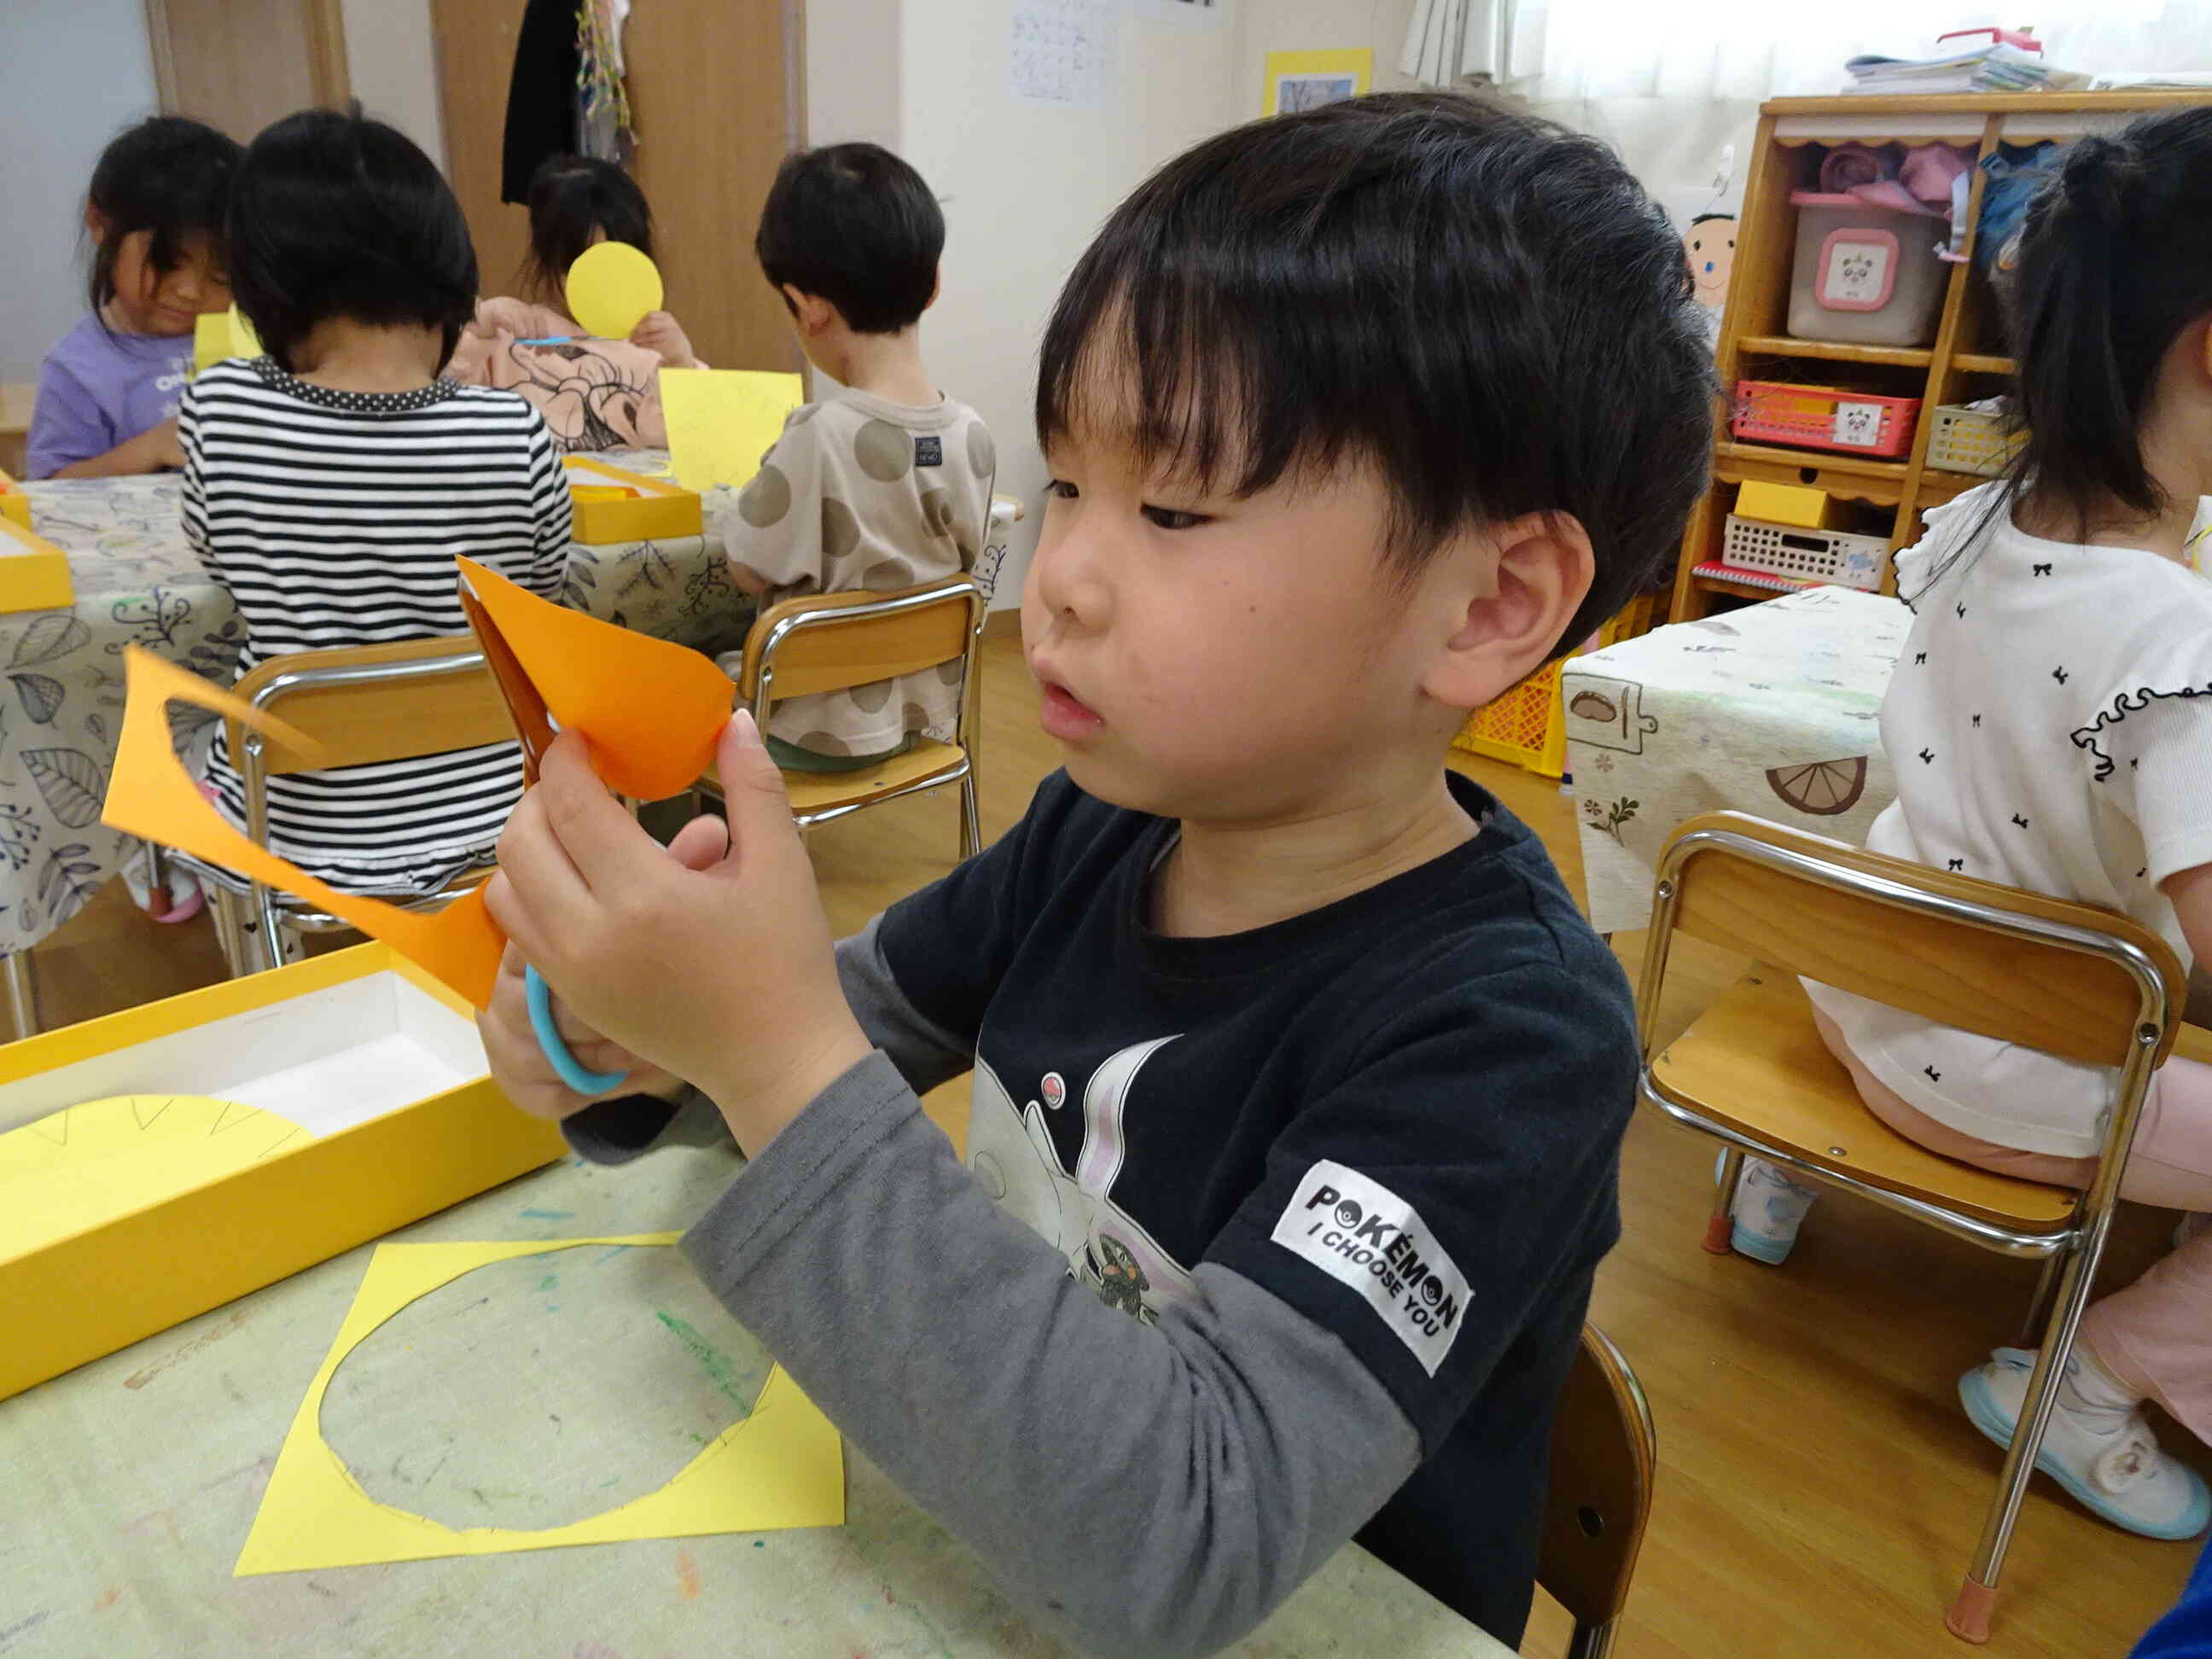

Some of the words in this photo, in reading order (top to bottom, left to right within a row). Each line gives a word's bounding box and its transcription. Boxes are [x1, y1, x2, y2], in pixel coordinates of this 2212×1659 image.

[1307, 1221, 1324, 1236] I
[1322, 1231, 1406, 1299] CHOOSE
[1403, 1295, 1441, 1338] YOU
